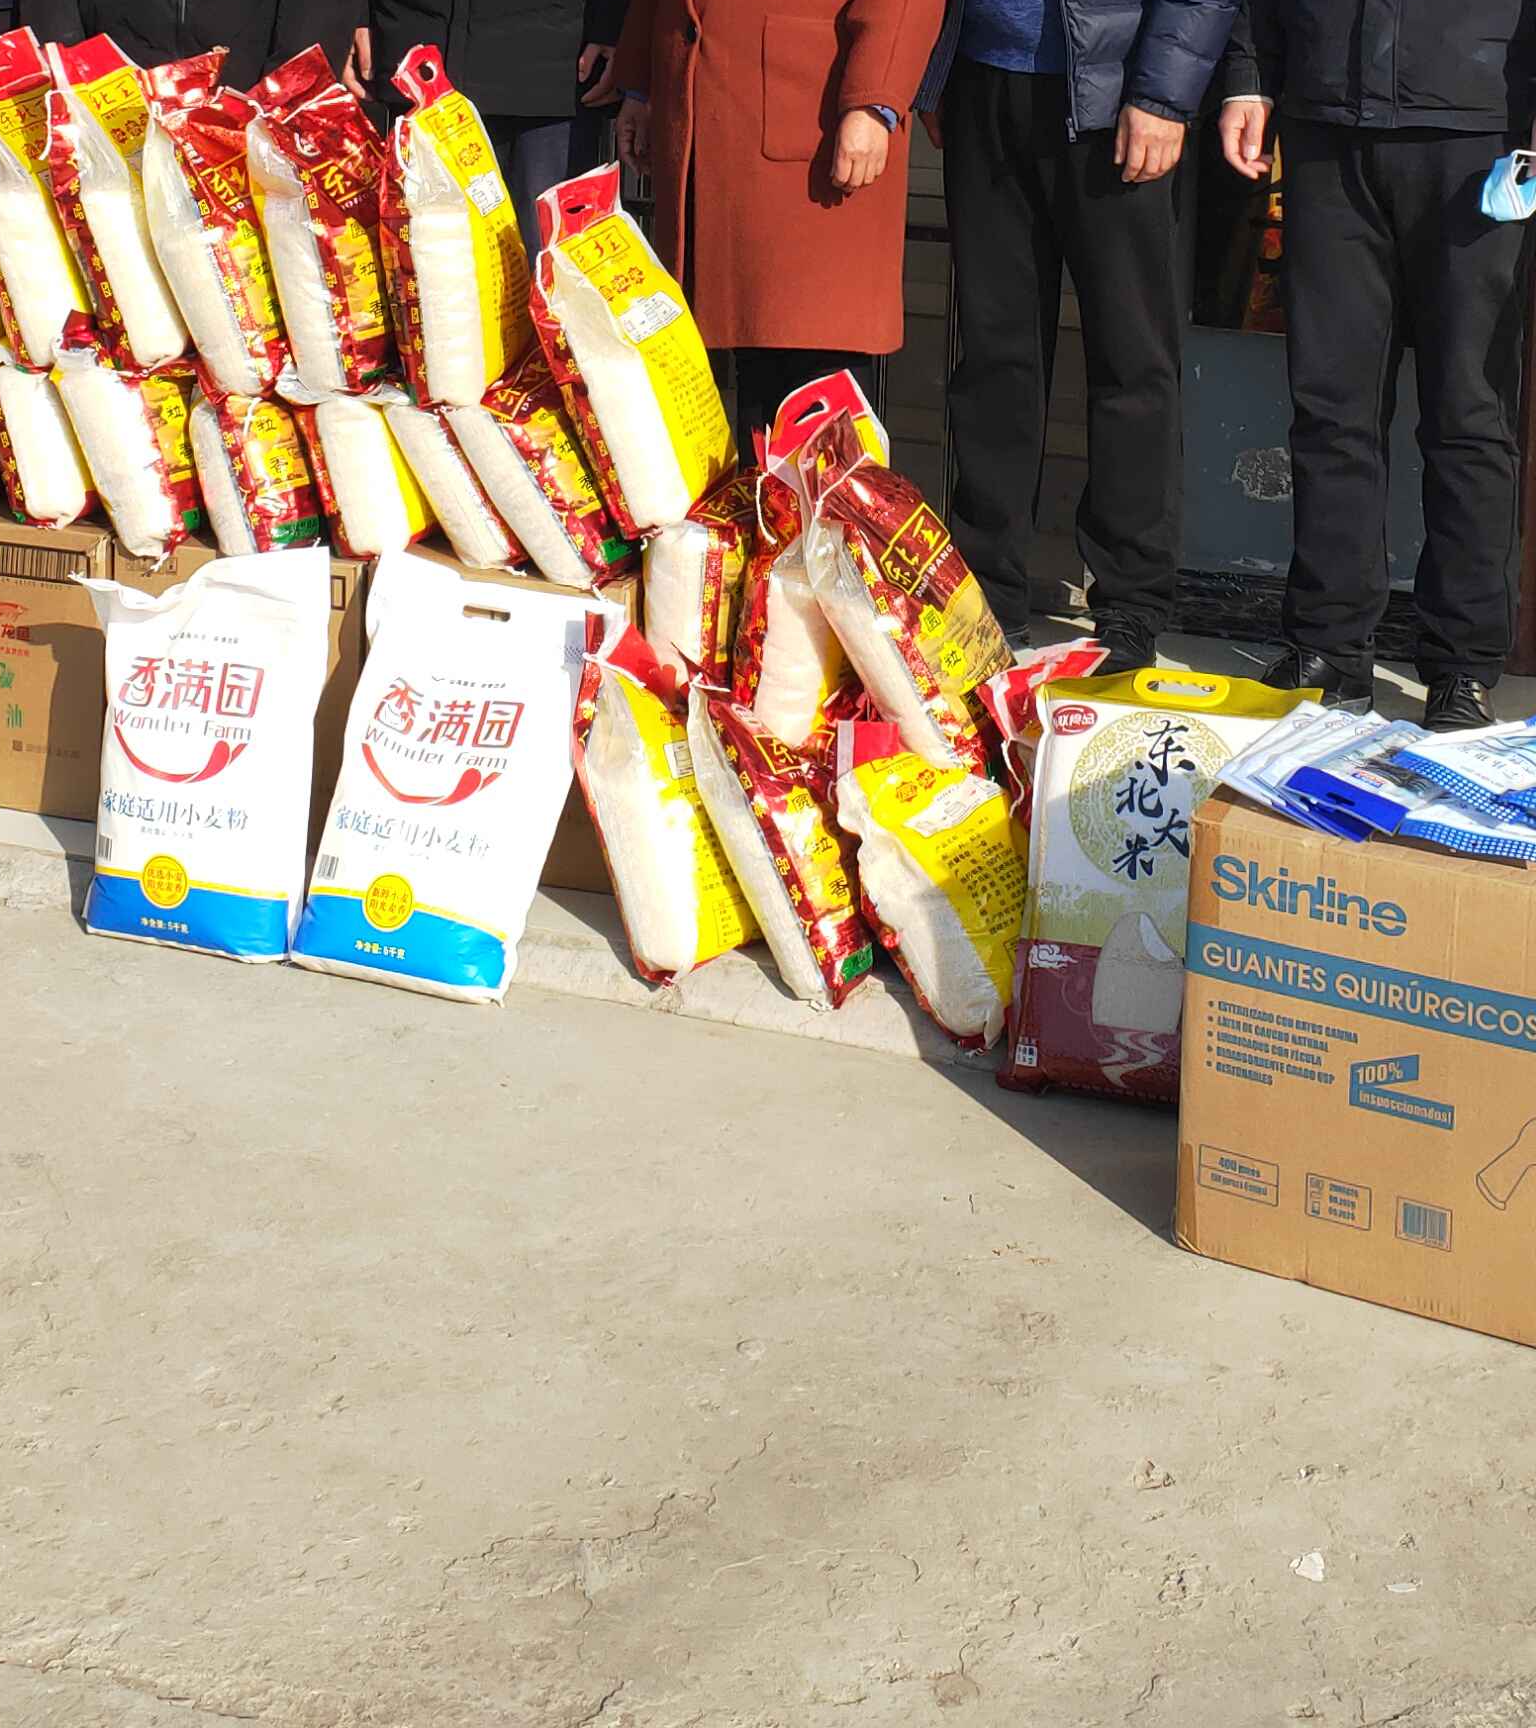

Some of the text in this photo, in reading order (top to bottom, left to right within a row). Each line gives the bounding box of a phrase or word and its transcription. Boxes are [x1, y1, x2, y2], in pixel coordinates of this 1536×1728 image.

[117, 655, 266, 719] 香满园
[373, 676, 526, 748] 香满园
[112, 706, 253, 742] Wonder Farm
[102, 787, 250, 832] 家庭适用小麦粉
[1210, 853, 1409, 938] Skinline
[1201, 940, 1329, 996] GUANTES
[1356, 1061, 1404, 1085] 100%
